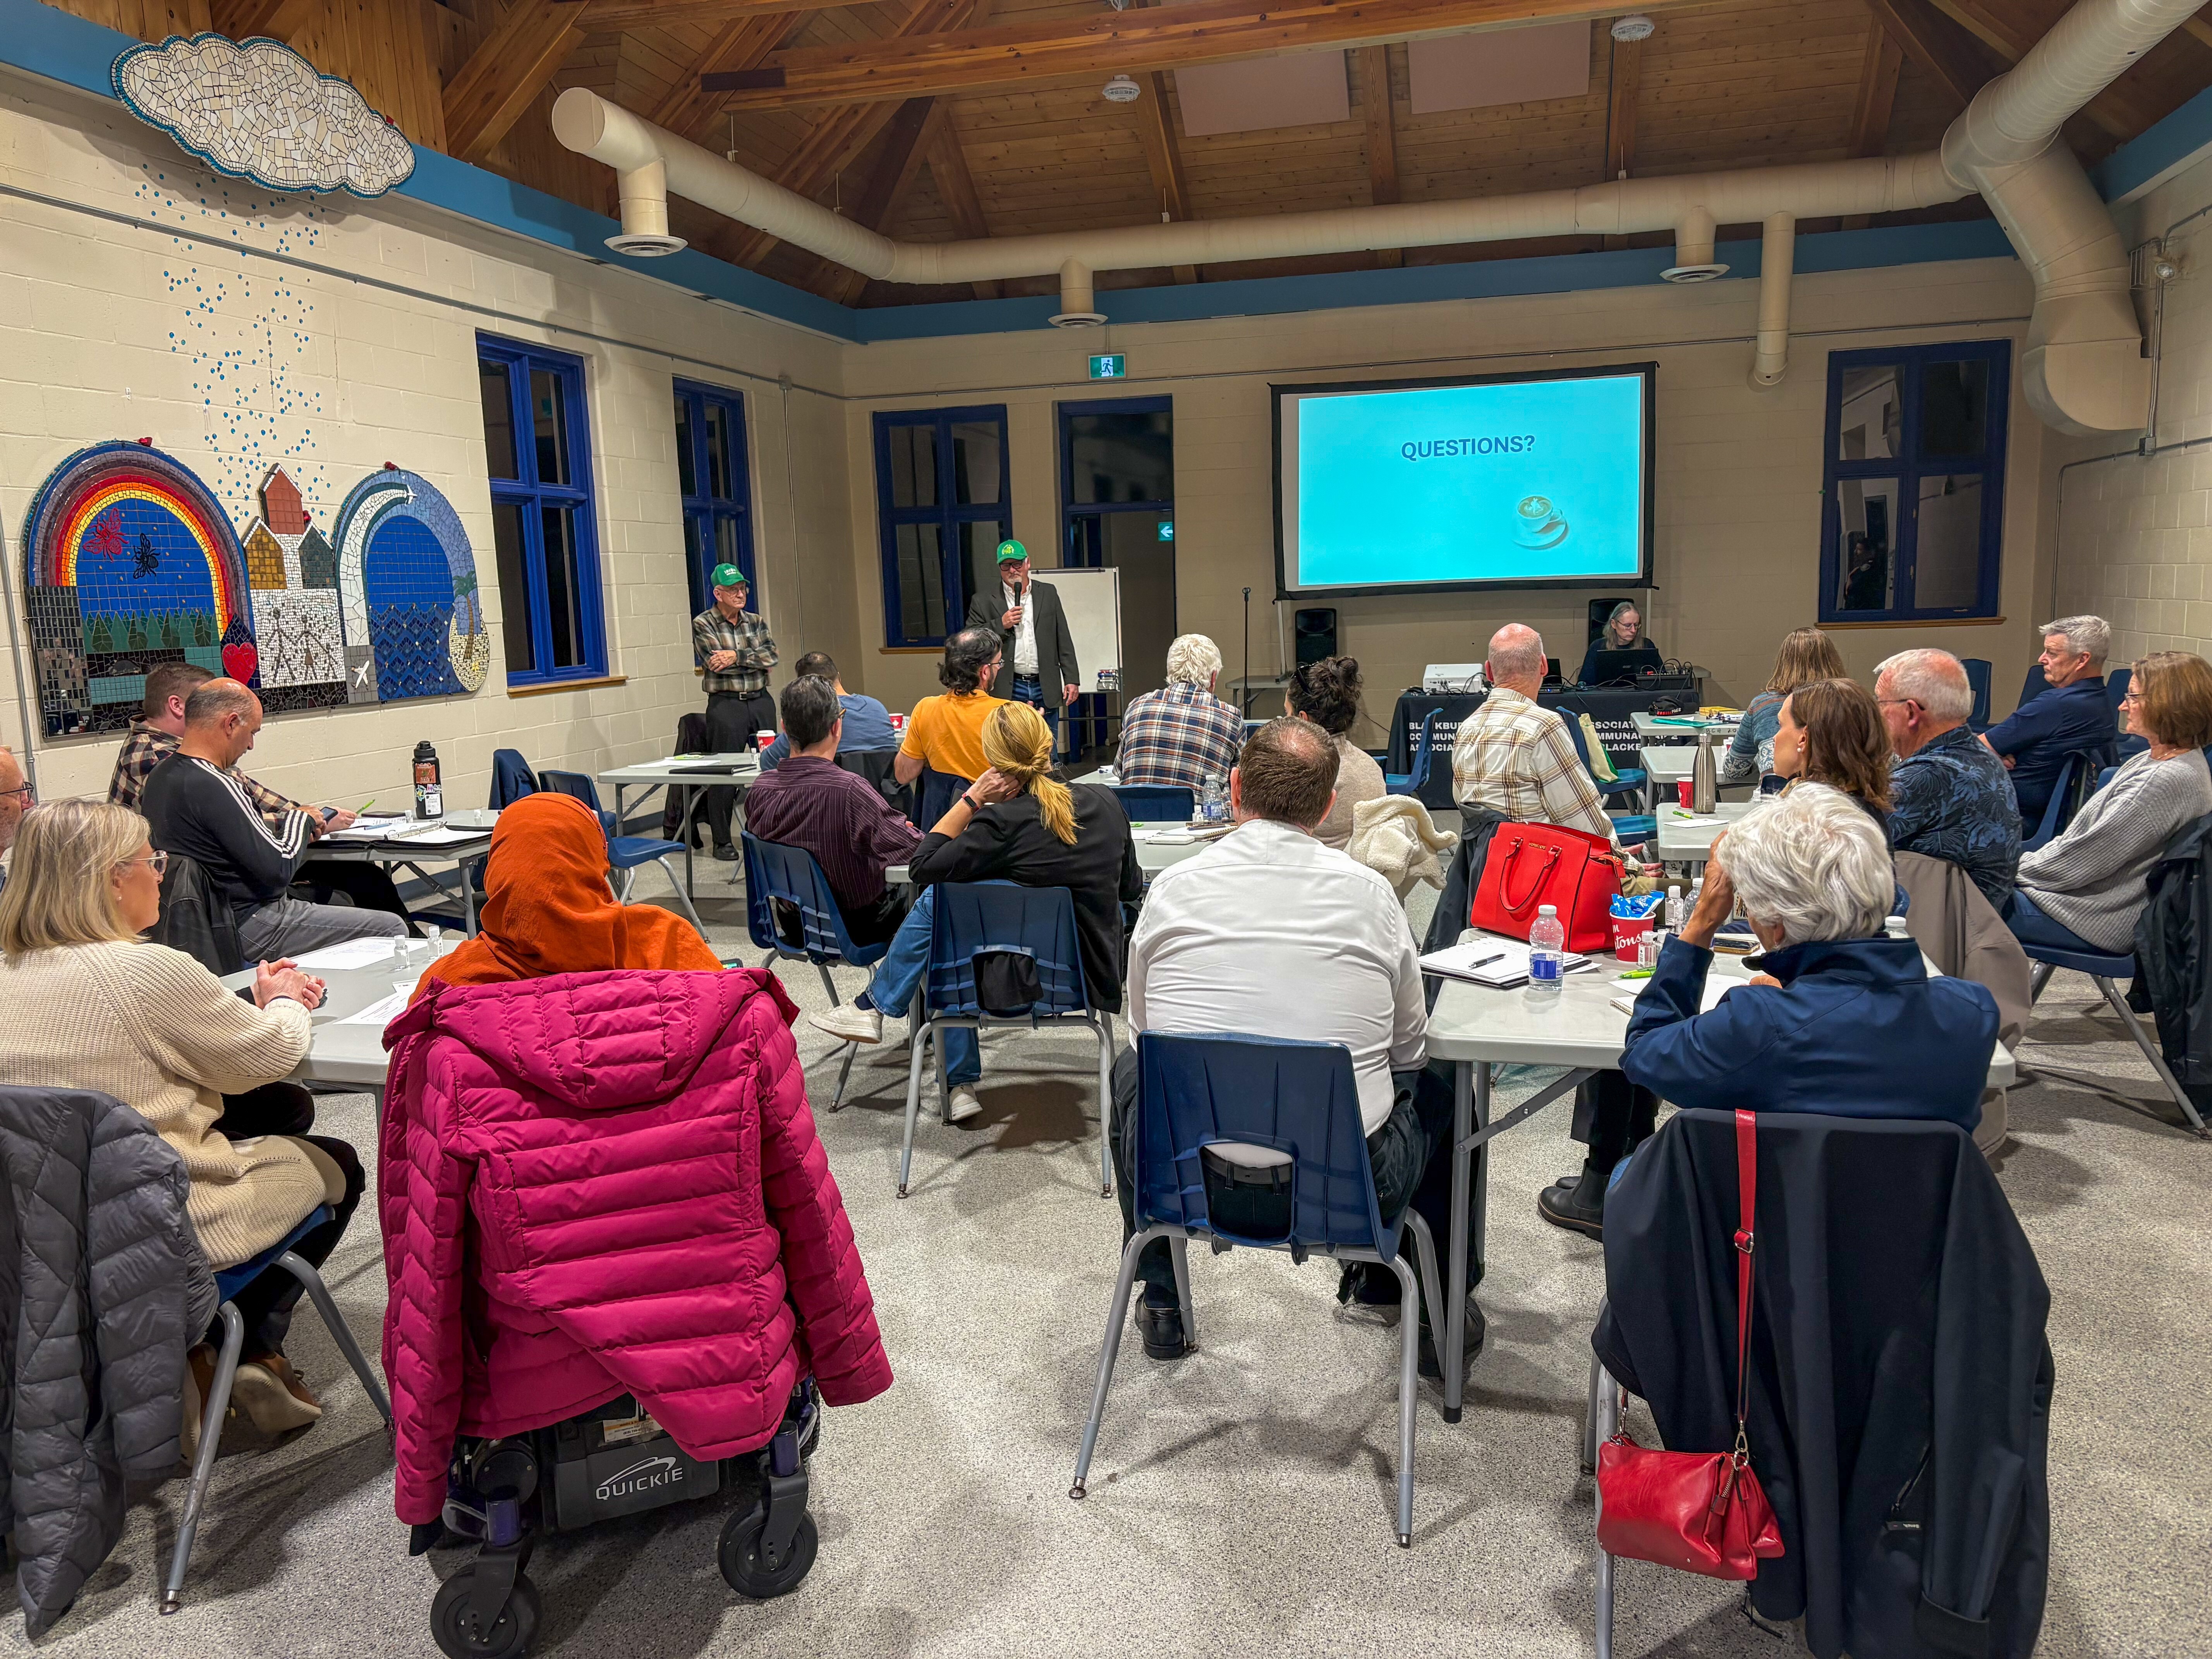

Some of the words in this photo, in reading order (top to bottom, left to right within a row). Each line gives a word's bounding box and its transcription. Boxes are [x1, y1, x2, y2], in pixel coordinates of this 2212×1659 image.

[1401, 435, 1535, 462] QUESTIONS?
[1614, 933, 1642, 950] tons
[596, 1467, 683, 1500] QUICKIE
